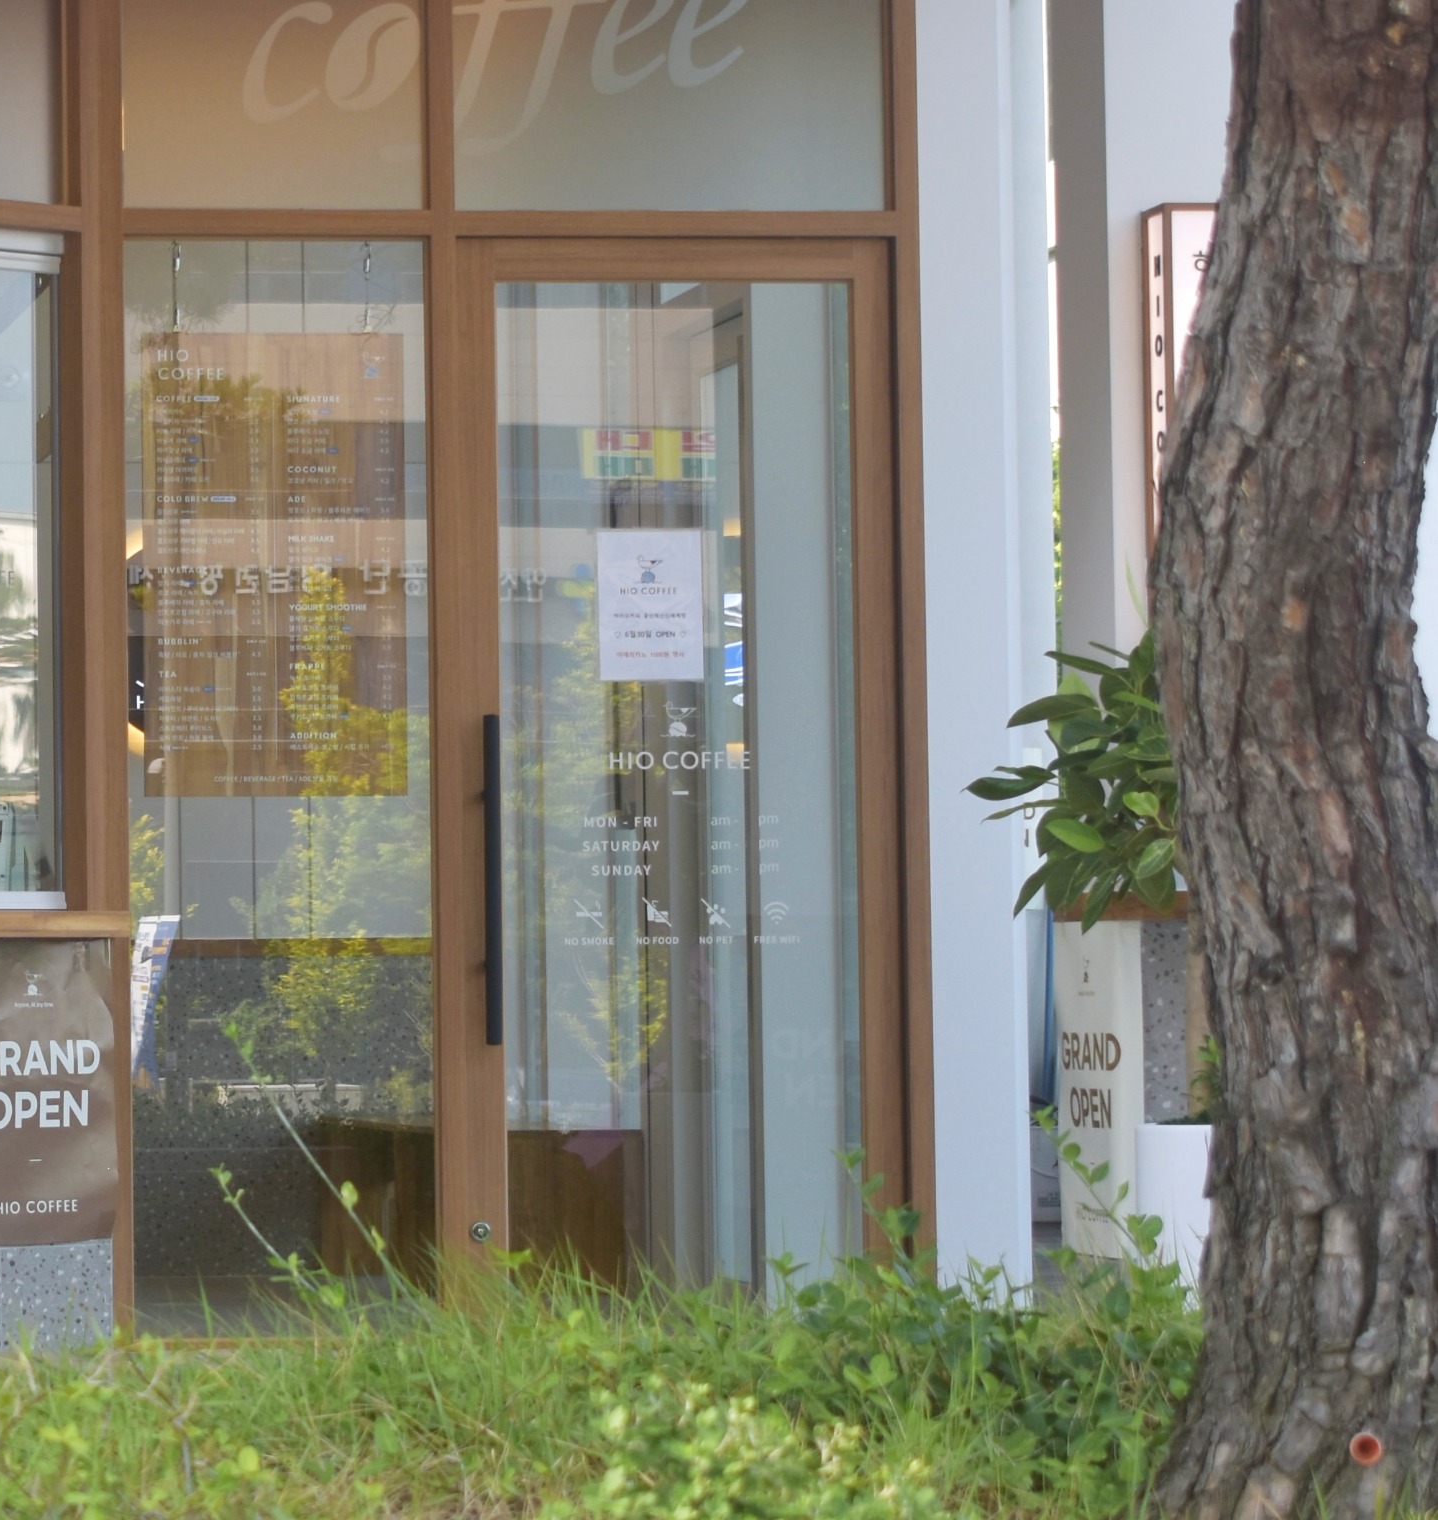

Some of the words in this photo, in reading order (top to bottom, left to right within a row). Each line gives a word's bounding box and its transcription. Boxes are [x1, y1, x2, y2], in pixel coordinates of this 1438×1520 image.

[157, 349, 189, 362] HIO
[158, 367, 225, 381] COFFEE
[287, 466, 337, 474] COCONUT
[157, 495, 182, 503] COLD
[185, 495, 209, 503] BREW
[619, 587, 638, 595] HIO
[641, 587, 678, 595] COFFEE
[655, 630, 676, 638] OPEN
[609, 751, 654, 770] HIO
[662, 750, 750, 770] COFFEE
[583, 816, 617, 828] MON
[634, 816, 658, 828] FRI
[710, 816, 731, 826] am
[582, 840, 660, 852] SATURDAY
[710, 841, 731, 850] am
[591, 864, 652, 877] SUNDAY
[711, 865, 732, 874] am
[565, 937, 579, 945] NO
[581, 937, 614, 945] SMOKE
[636, 936, 650, 945] NO
[652, 936, 679, 945] FOOD
[699, 936, 713, 944] NO
[715, 936, 734, 944] PET
[754, 935, 778, 944] FREE
[1062, 1031, 1122, 1072] GRAND
[1070, 1086, 1112, 1130] OPEN
[26, 1199, 79, 1215] COFFEE
